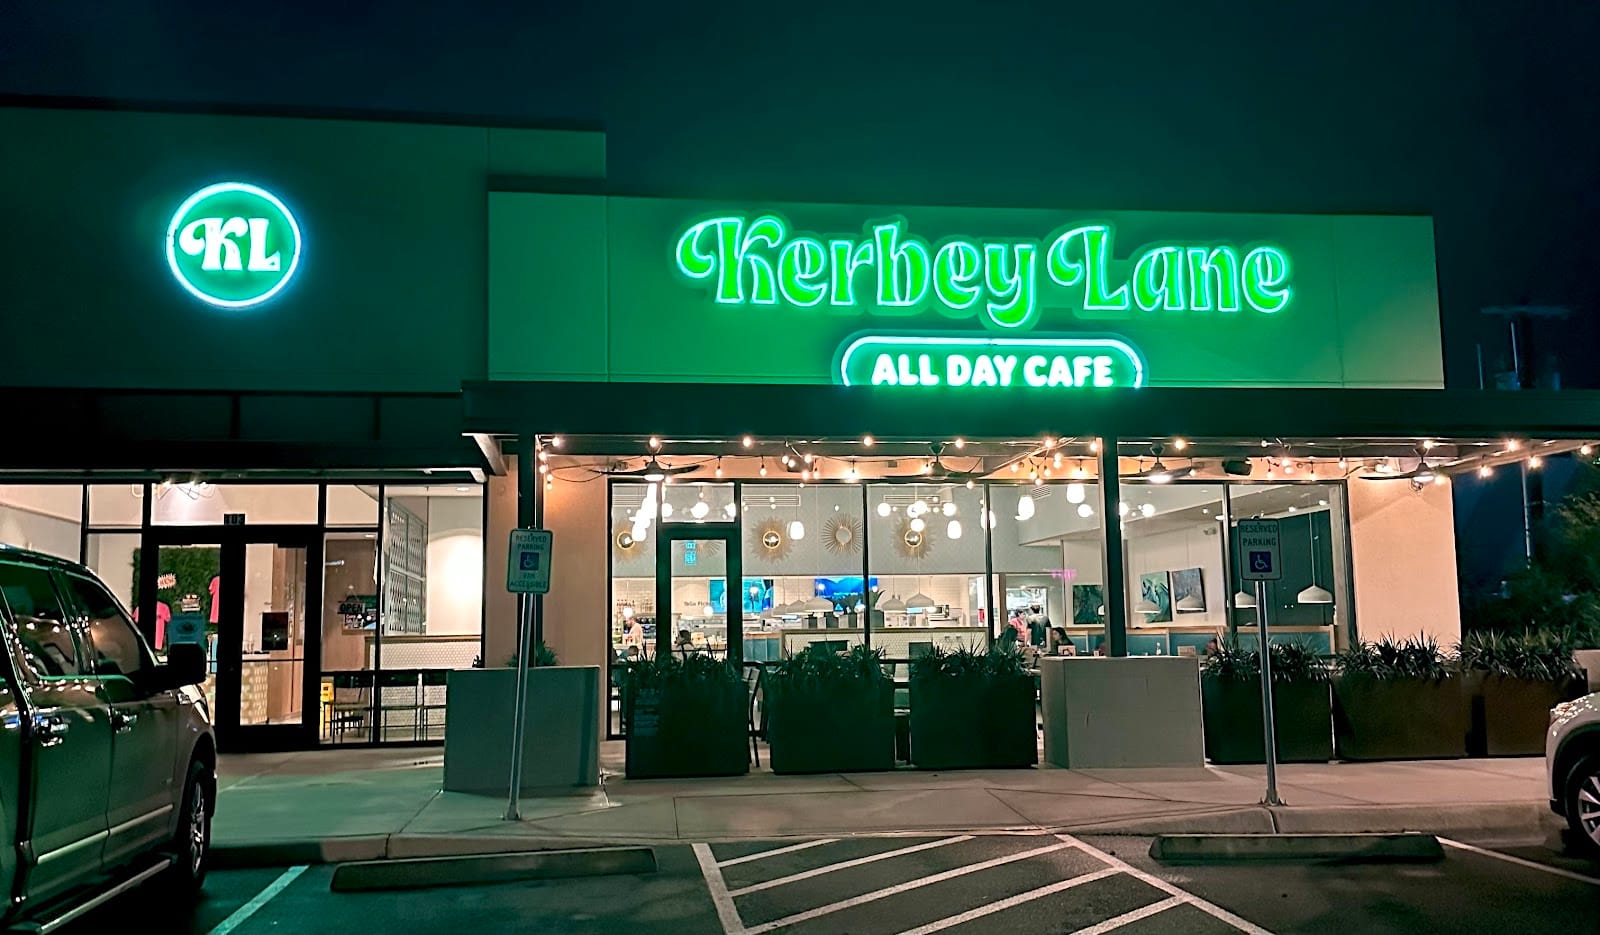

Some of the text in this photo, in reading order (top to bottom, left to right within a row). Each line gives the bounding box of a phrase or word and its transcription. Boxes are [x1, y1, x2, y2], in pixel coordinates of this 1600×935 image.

[178, 216, 281, 272] KL
[676, 215, 1292, 328] Kerbey Lane
[871, 353, 1114, 388] ALL DAY CAFE
[1240, 524, 1278, 533] RESERVED
[515, 534, 547, 543] RESERVED
[1242, 537, 1276, 546] PARKING
[517, 543, 545, 551] PARKING
[340, 603, 363, 613] OPEN
